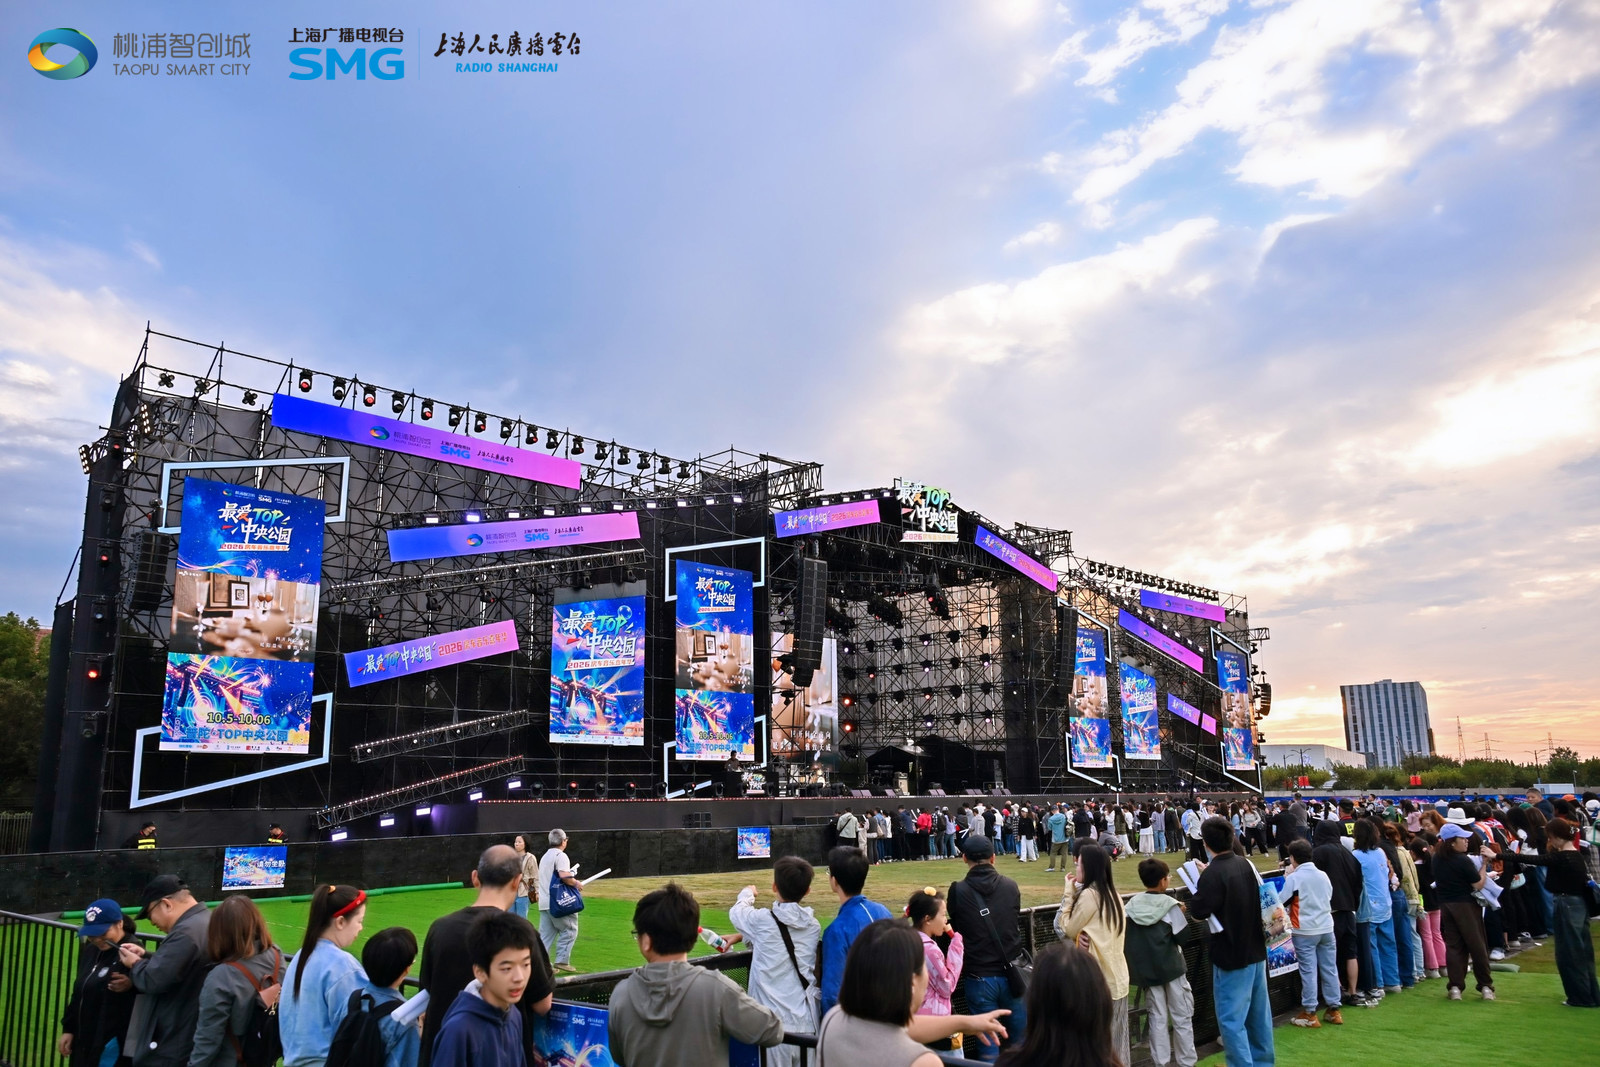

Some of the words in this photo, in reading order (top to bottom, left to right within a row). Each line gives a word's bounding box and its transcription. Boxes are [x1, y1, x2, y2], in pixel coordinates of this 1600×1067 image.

[440, 445, 471, 460] SMG
[217, 501, 284, 527] 最爱TOP
[241, 517, 294, 544] 中央公园
[524, 532, 550, 542] SMG
[707, 588, 737, 608] 中央公园
[562, 608, 628, 638] 最爱TOP
[585, 627, 639, 660] 中央公园
[206, 712, 271, 726] 10.5-10.06
[698, 731, 734, 741] 10.5-10.06
[571, 1016, 586, 1026] SMG
